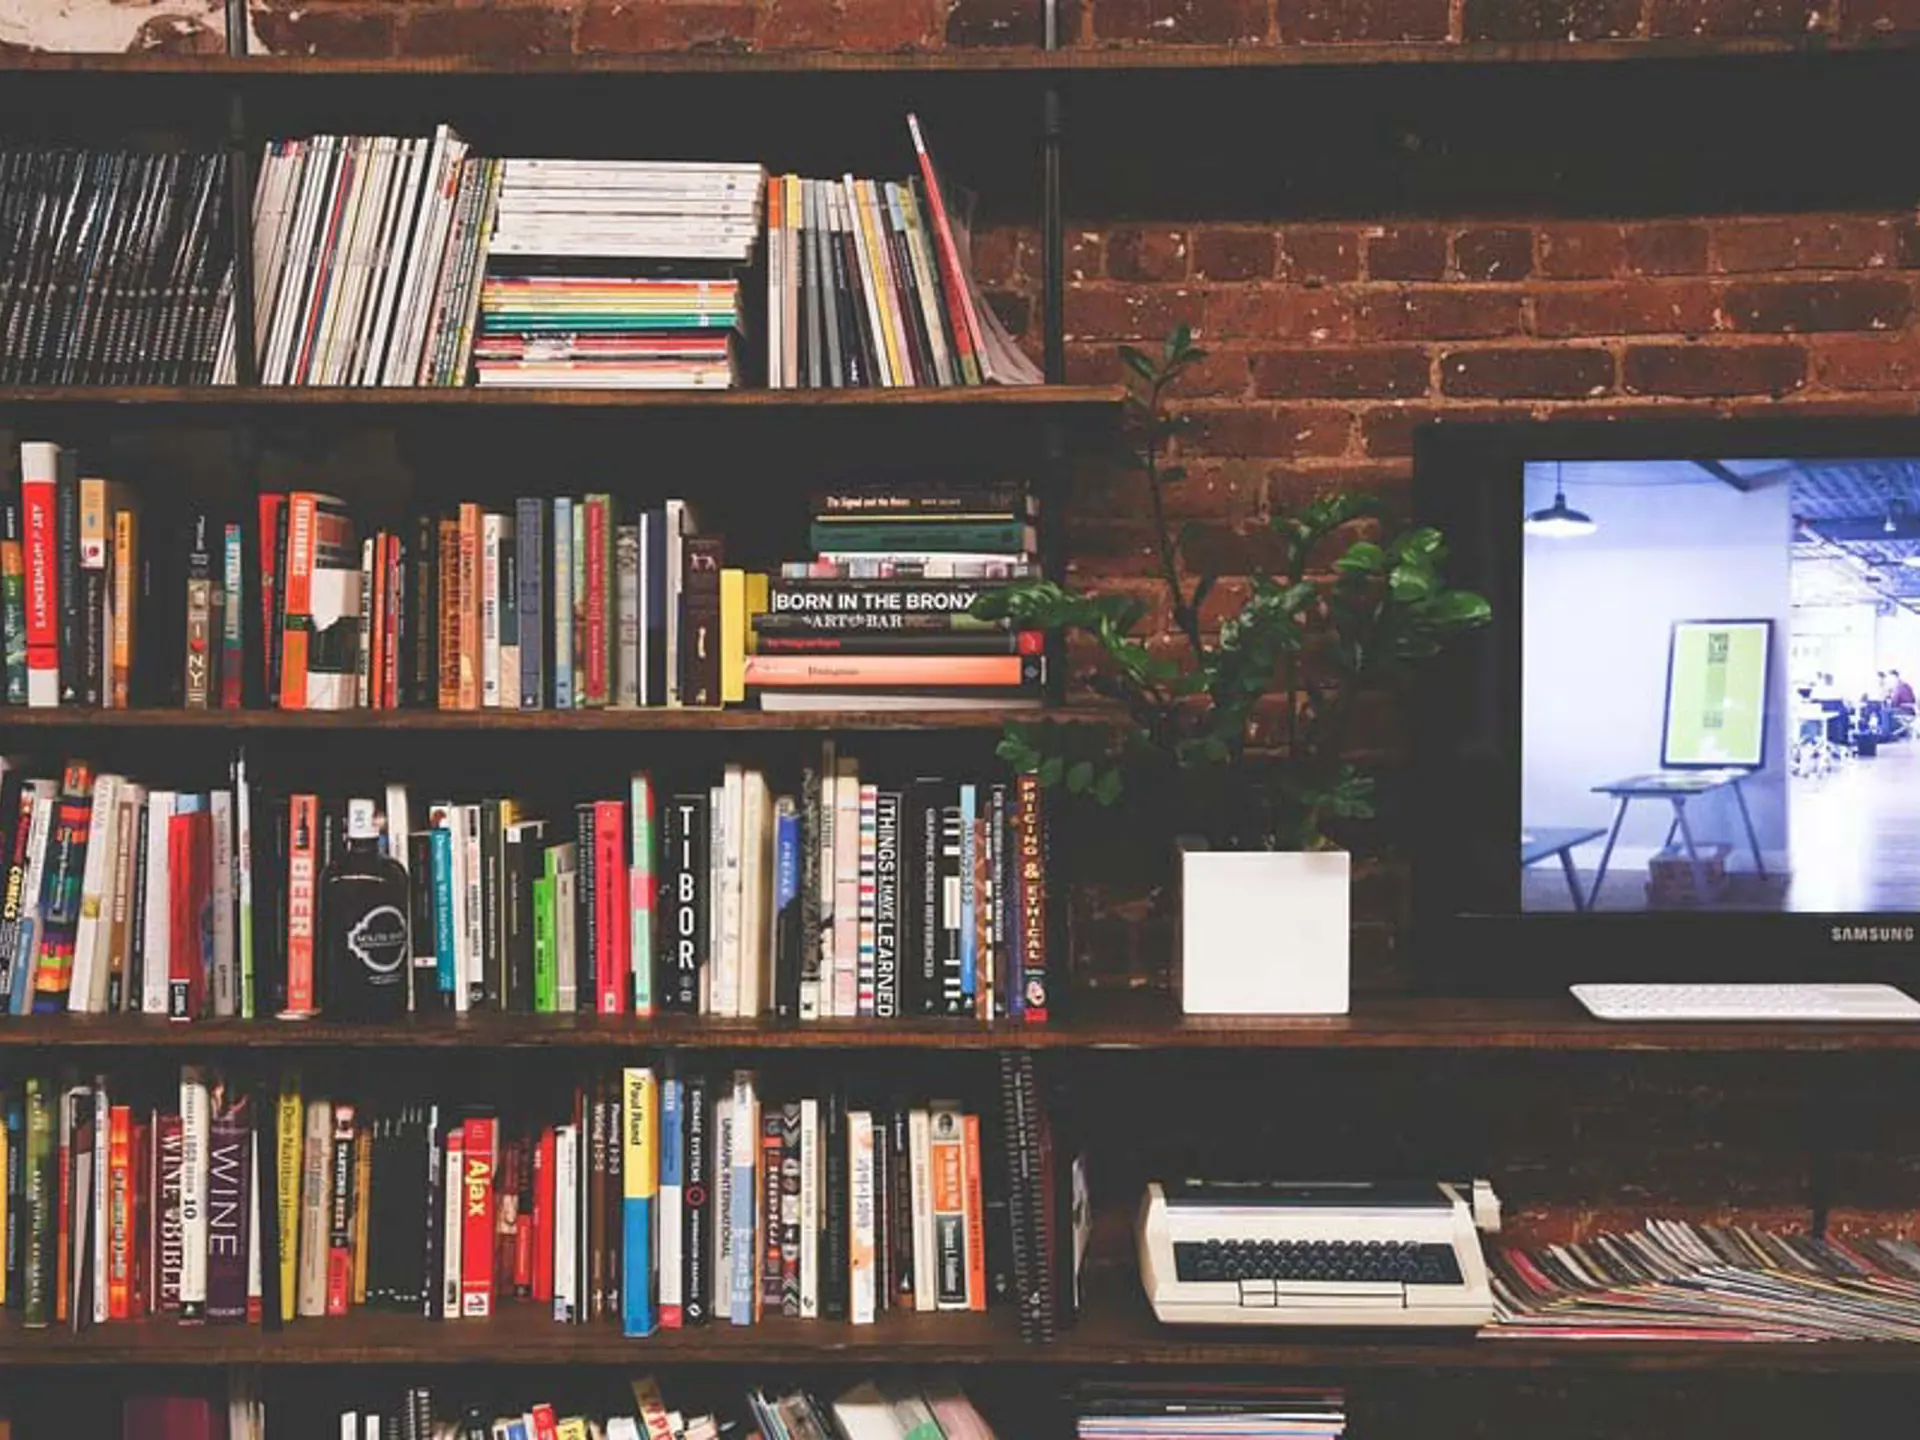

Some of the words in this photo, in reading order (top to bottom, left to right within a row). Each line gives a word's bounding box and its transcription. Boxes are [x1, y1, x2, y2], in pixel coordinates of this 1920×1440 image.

[777, 593, 833, 610] BORN
[839, 593, 858, 610] IN
[862, 593, 901, 610] THE
[812, 614, 847, 628] ART
[867, 614, 902, 628] BAR
[879, 806, 895, 872] THINGS
[3, 866, 23, 919] COMICS
[291, 857, 312, 936] BEER
[679, 806, 695, 970] TIBOR
[1831, 927, 1914, 941] SAMSUNG
[879, 923, 895, 1017] LEARNED
[630, 1081, 643, 1109] Paul
[630, 1112, 643, 1145] Rand
[161, 1133, 183, 1199] WINE
[691, 1136, 702, 1183] SYSTEMS
[183, 1198, 197, 1220] 10
[208, 1144, 240, 1256] WINE
[465, 1159, 491, 1217] Ajax
[161, 1221, 183, 1297] BIBLE
